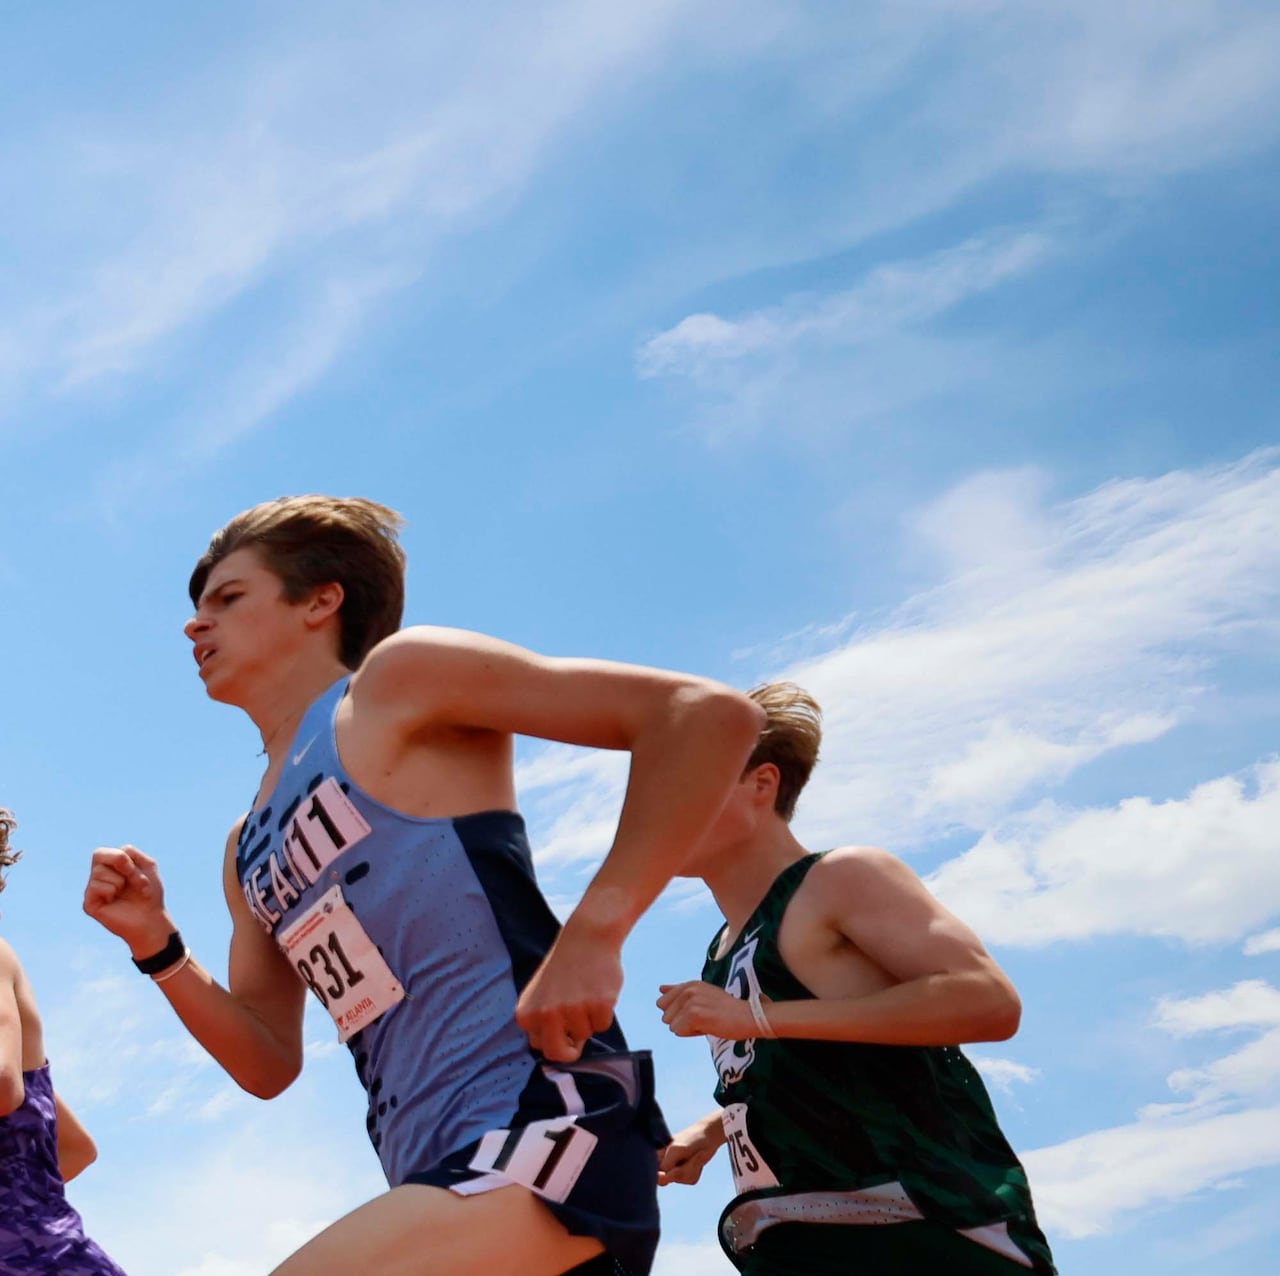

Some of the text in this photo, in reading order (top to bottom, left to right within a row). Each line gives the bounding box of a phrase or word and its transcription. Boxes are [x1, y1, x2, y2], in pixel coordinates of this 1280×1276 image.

[291, 794, 347, 872] 11
[297, 930, 365, 1009] 831
[345, 997, 375, 1022] ATLANTA
